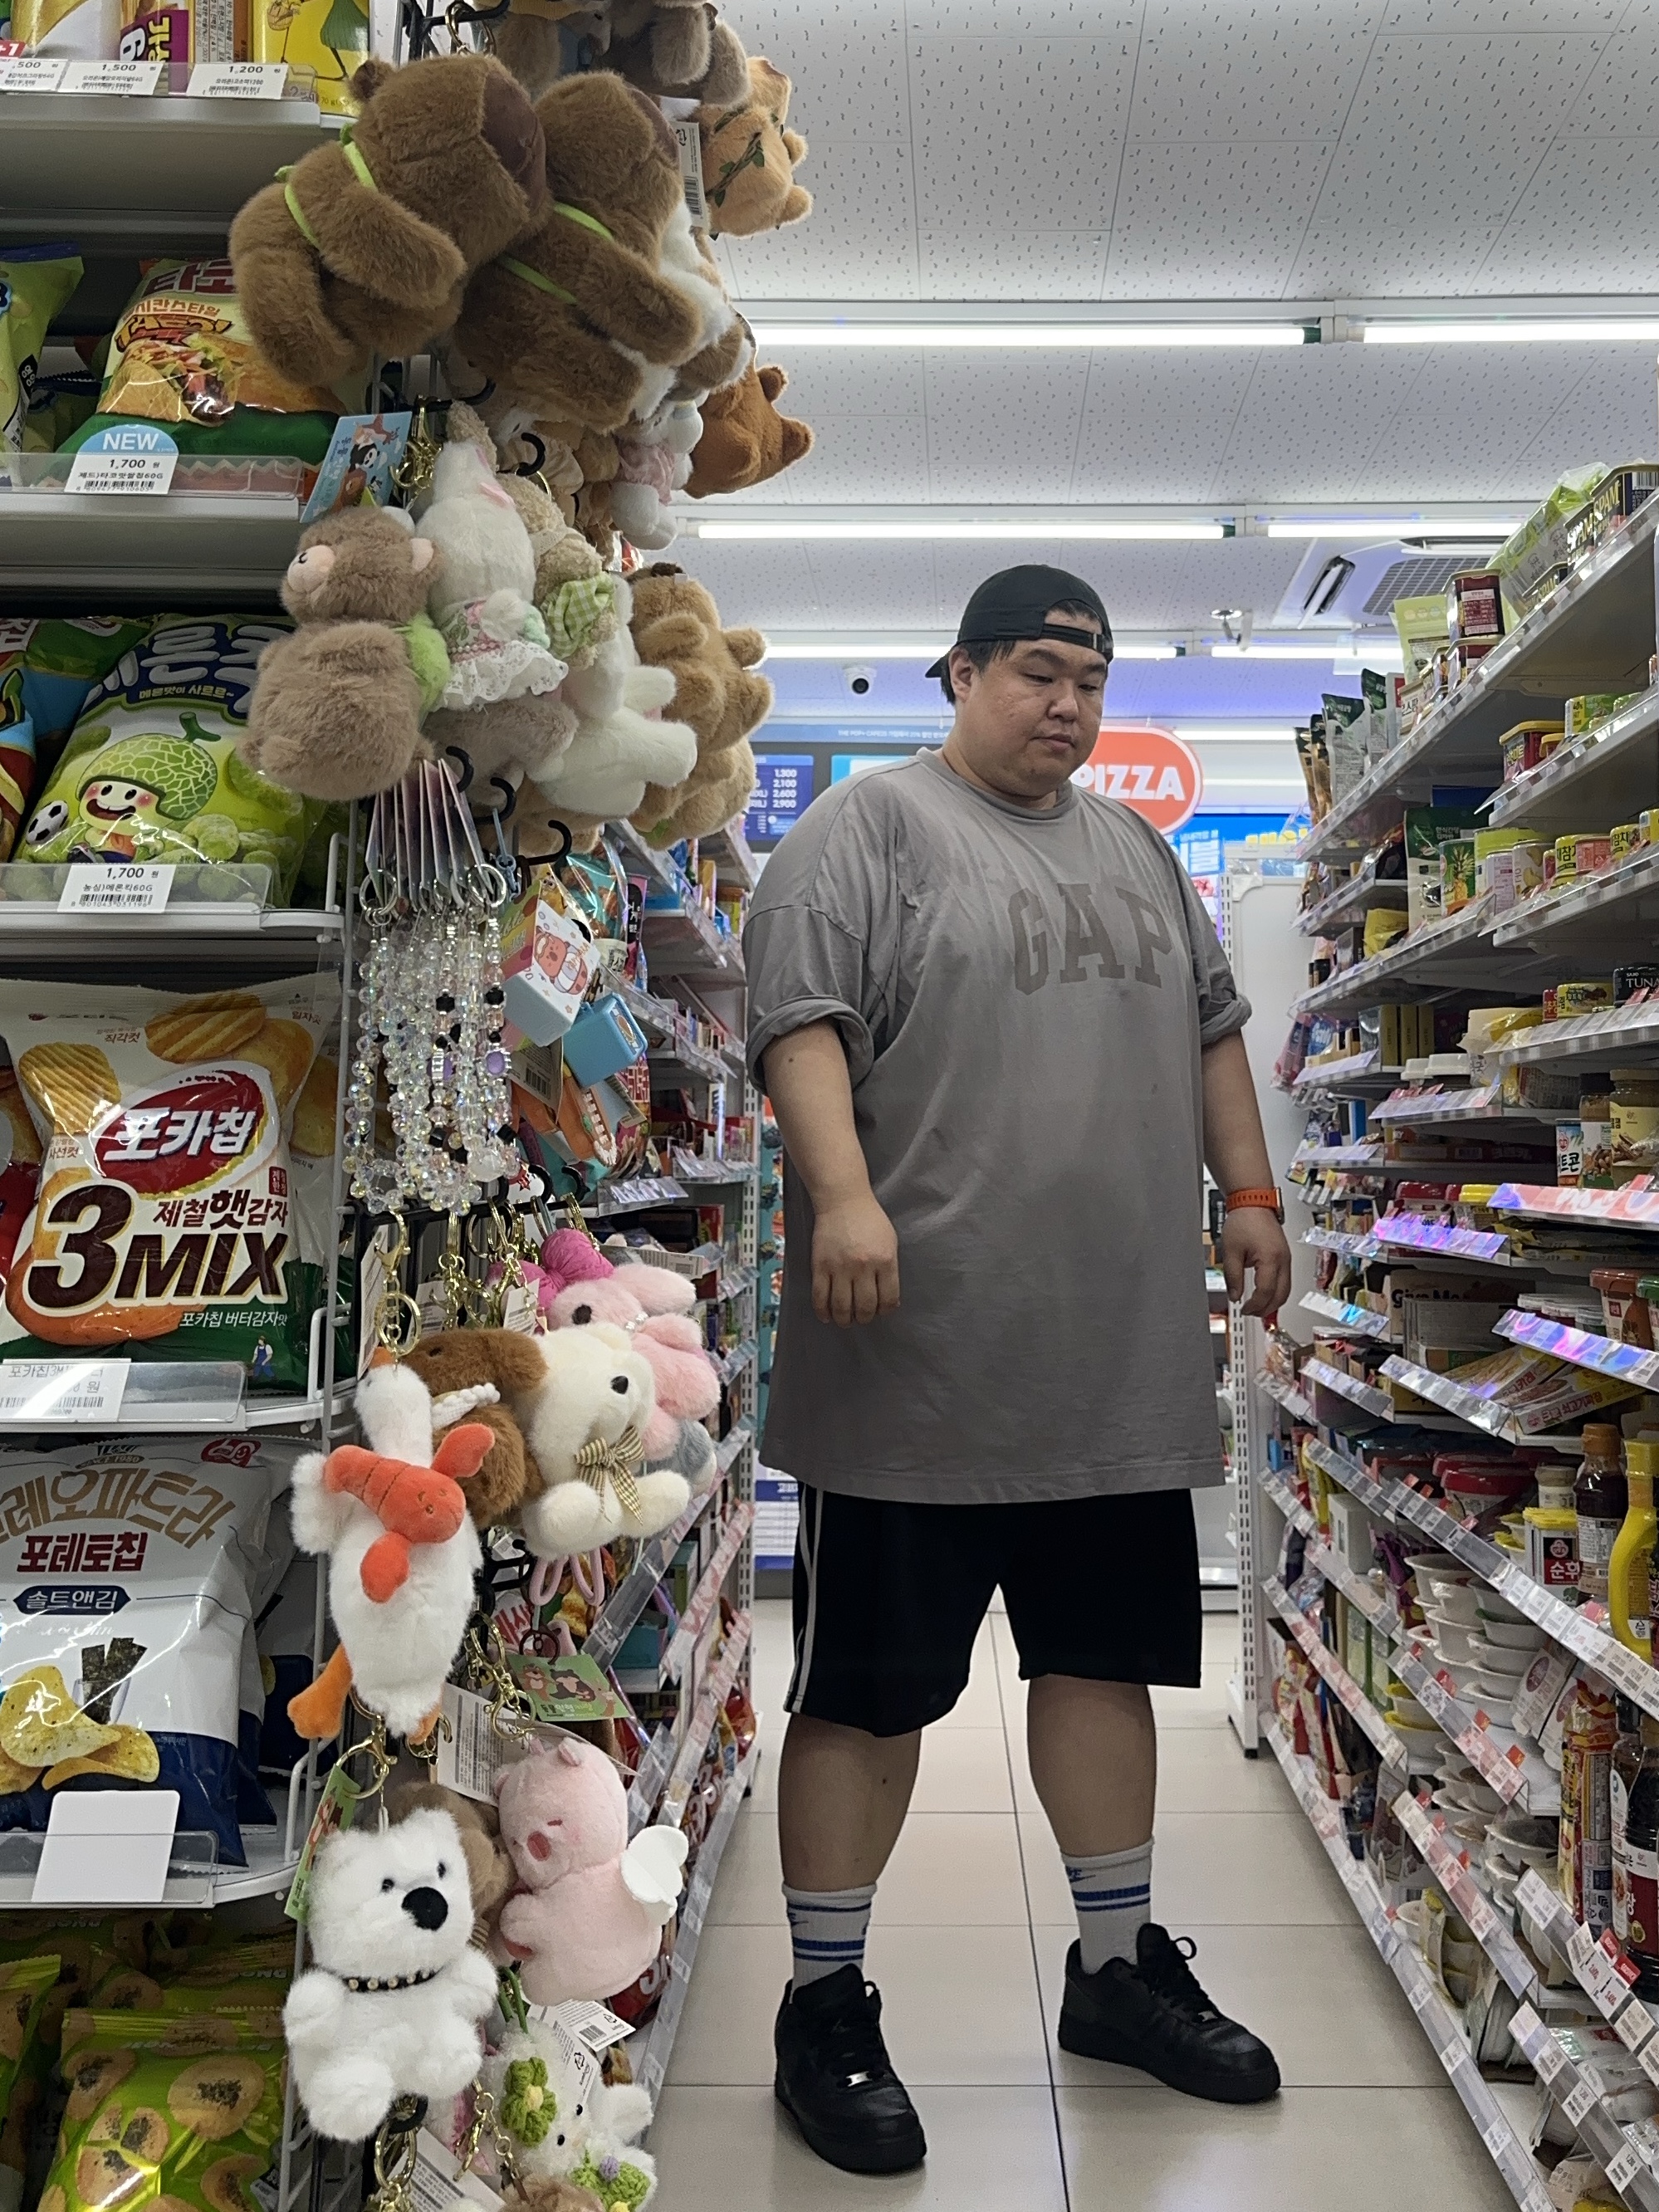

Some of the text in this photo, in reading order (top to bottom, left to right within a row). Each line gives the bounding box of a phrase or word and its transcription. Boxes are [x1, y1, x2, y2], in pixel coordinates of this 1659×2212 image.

[101, 64, 137, 72] 1,500
[228, 66, 263, 75] 1,200
[133, 298, 221, 317] 시칸스타일
[102, 433, 159, 451] NEW
[109, 459, 146, 470] 1,700
[1069, 763, 1186, 801] PIZZA
[106, 868, 144, 879] 1,700
[83, 884, 154, 893] 농심)메론킥60G
[1007, 882, 1173, 996] GAP
[105, 1032, 140, 1044] 직각컷
[105, 1106, 257, 1160] 포카칩
[179, 1310, 288, 1328] 포카칩 버터감자맛
[86, 1381, 100, 1393] 원
[0, 1468, 236, 1549] 레오파트라
[17, 1531, 149, 1573] 포테토칩
[27, 1589, 119, 1610] 솔트앤김
